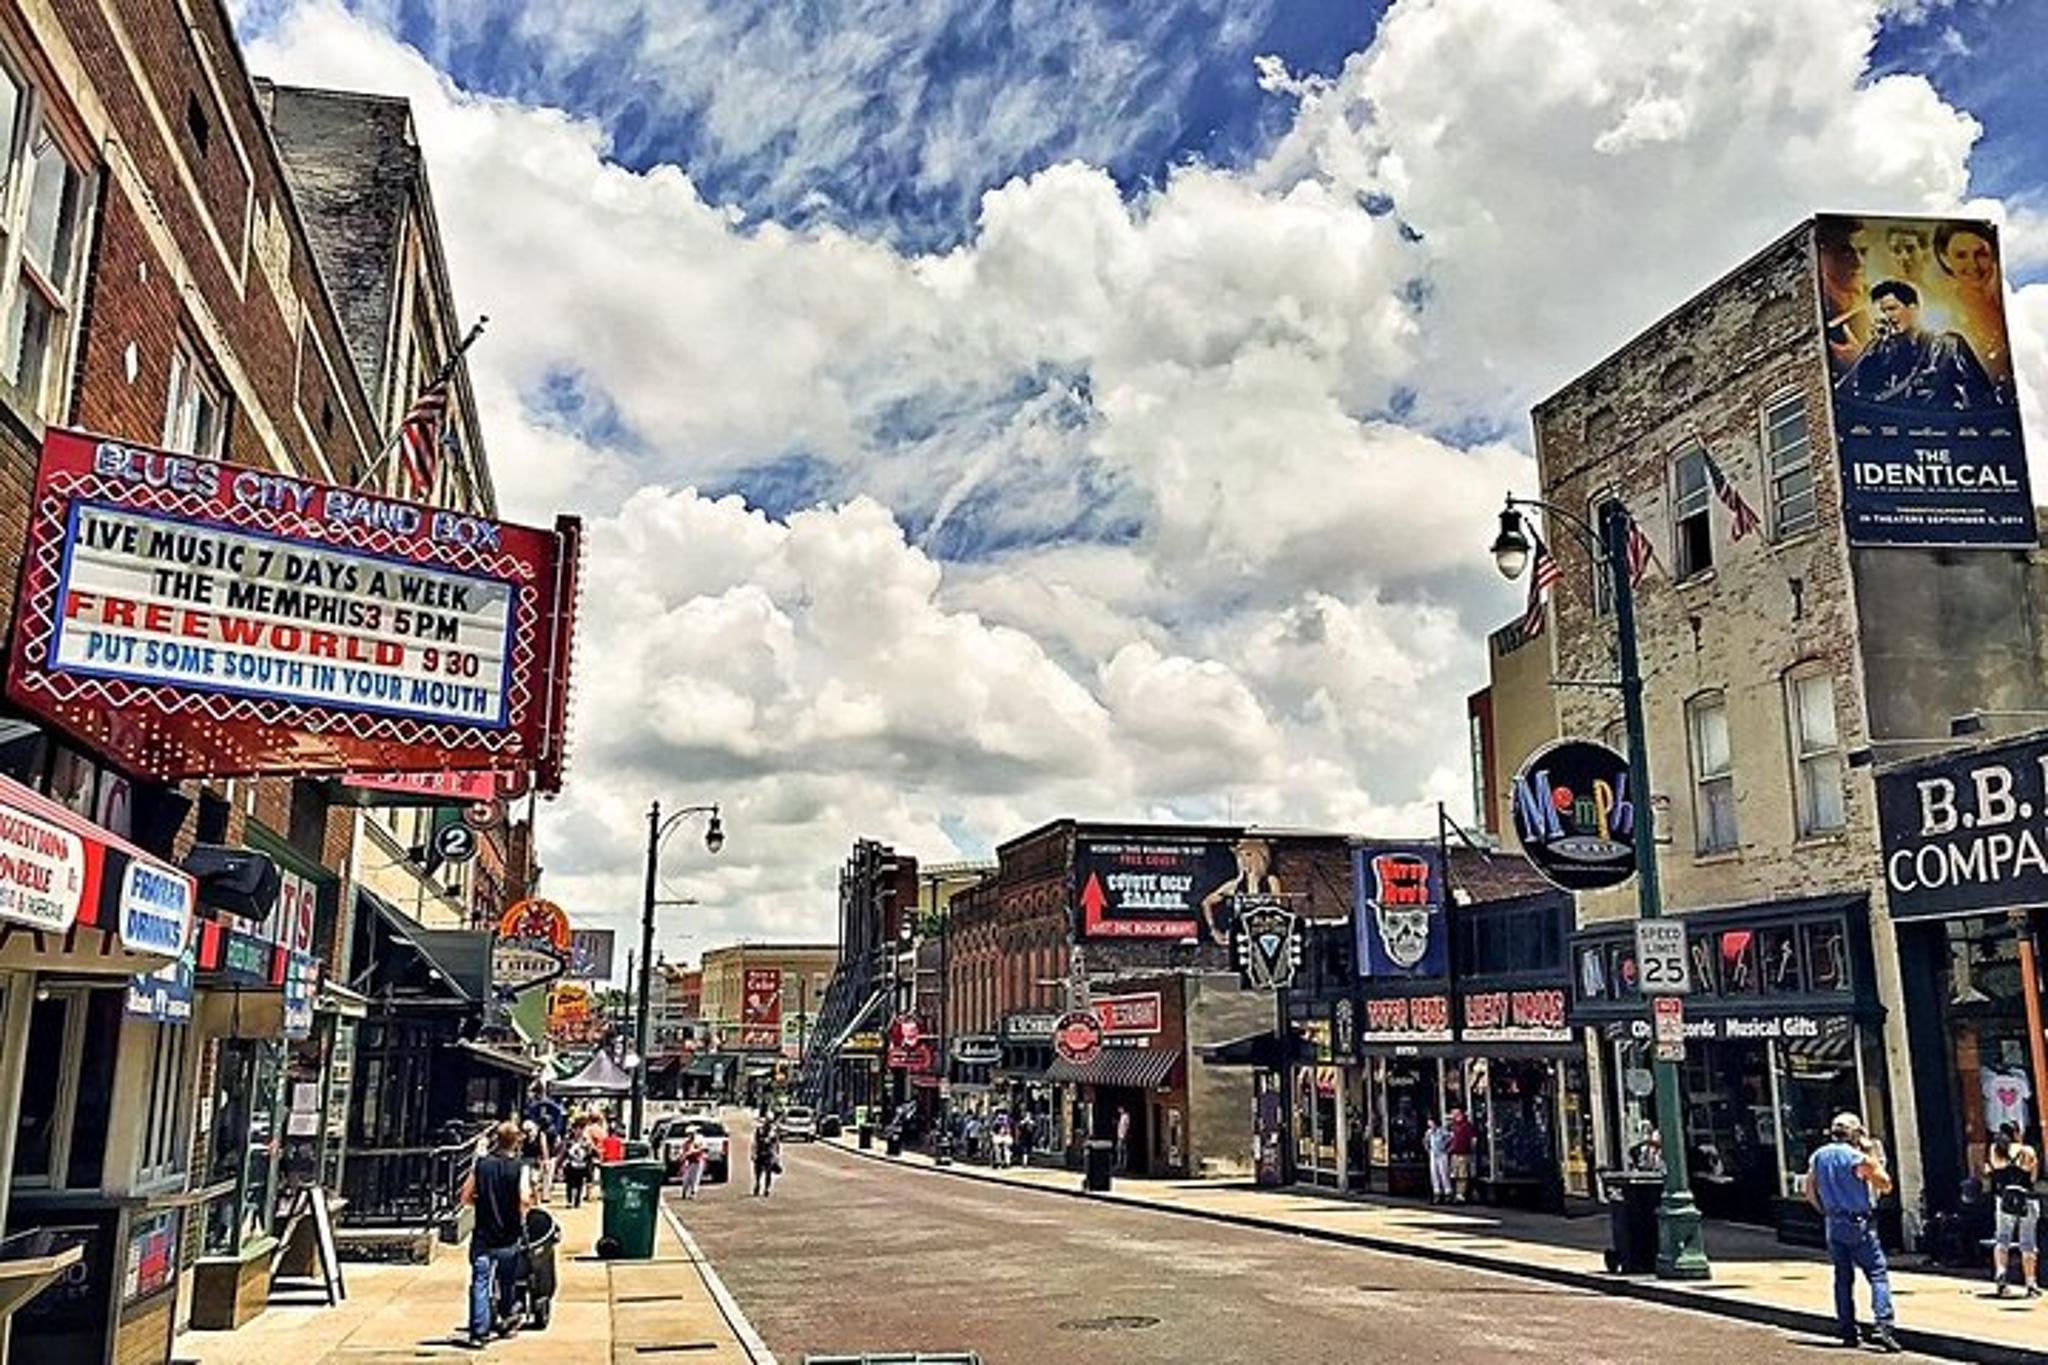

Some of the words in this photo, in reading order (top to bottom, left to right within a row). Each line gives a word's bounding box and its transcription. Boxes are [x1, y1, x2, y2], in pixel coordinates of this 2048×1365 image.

[1914, 449, 1951, 464] THE
[1853, 462, 2018, 486] IDENTICAL
[94, 441, 221, 497] BLUES
[233, 471, 316, 514] CITY
[323, 490, 421, 535] BAND
[432, 511, 500, 552] BOX
[151, 531, 244, 573] MUSIC
[258, 550, 273, 577] 7
[285, 554, 358, 592] DAYS
[369, 571, 387, 598] A
[400, 574, 470, 612] WEEK
[155, 568, 214, 605] THE
[65, 590, 405, 667] FREEWORLD
[87, 631, 139, 664] PUT
[145, 641, 216, 675] SOME
[223, 649, 302, 687] SOUTH
[311, 664, 336, 694] IN
[343, 669, 402, 701] YOUR
[410, 678, 488, 715] MOUTH
[1916, 765, 2032, 836] B.B.
[445, 828, 468, 855] 2
[1120, 855, 1142, 865] FREE
[130, 866, 186, 912] FROZEN
[1107, 873, 1157, 891] COYOTE
[1160, 874, 1192, 891] UGLY
[1122, 891, 1182, 906] SALOON
[126, 907, 181, 949] DRINKS
[1640, 927, 1681, 939] SPEED
[1644, 943, 1677, 953] LIMIT
[1644, 957, 1684, 982] 25
[1683, 1018, 1716, 1037] cords
[1726, 1016, 1781, 1037] Musical
[1783, 1014, 1818, 1037] Gifts
